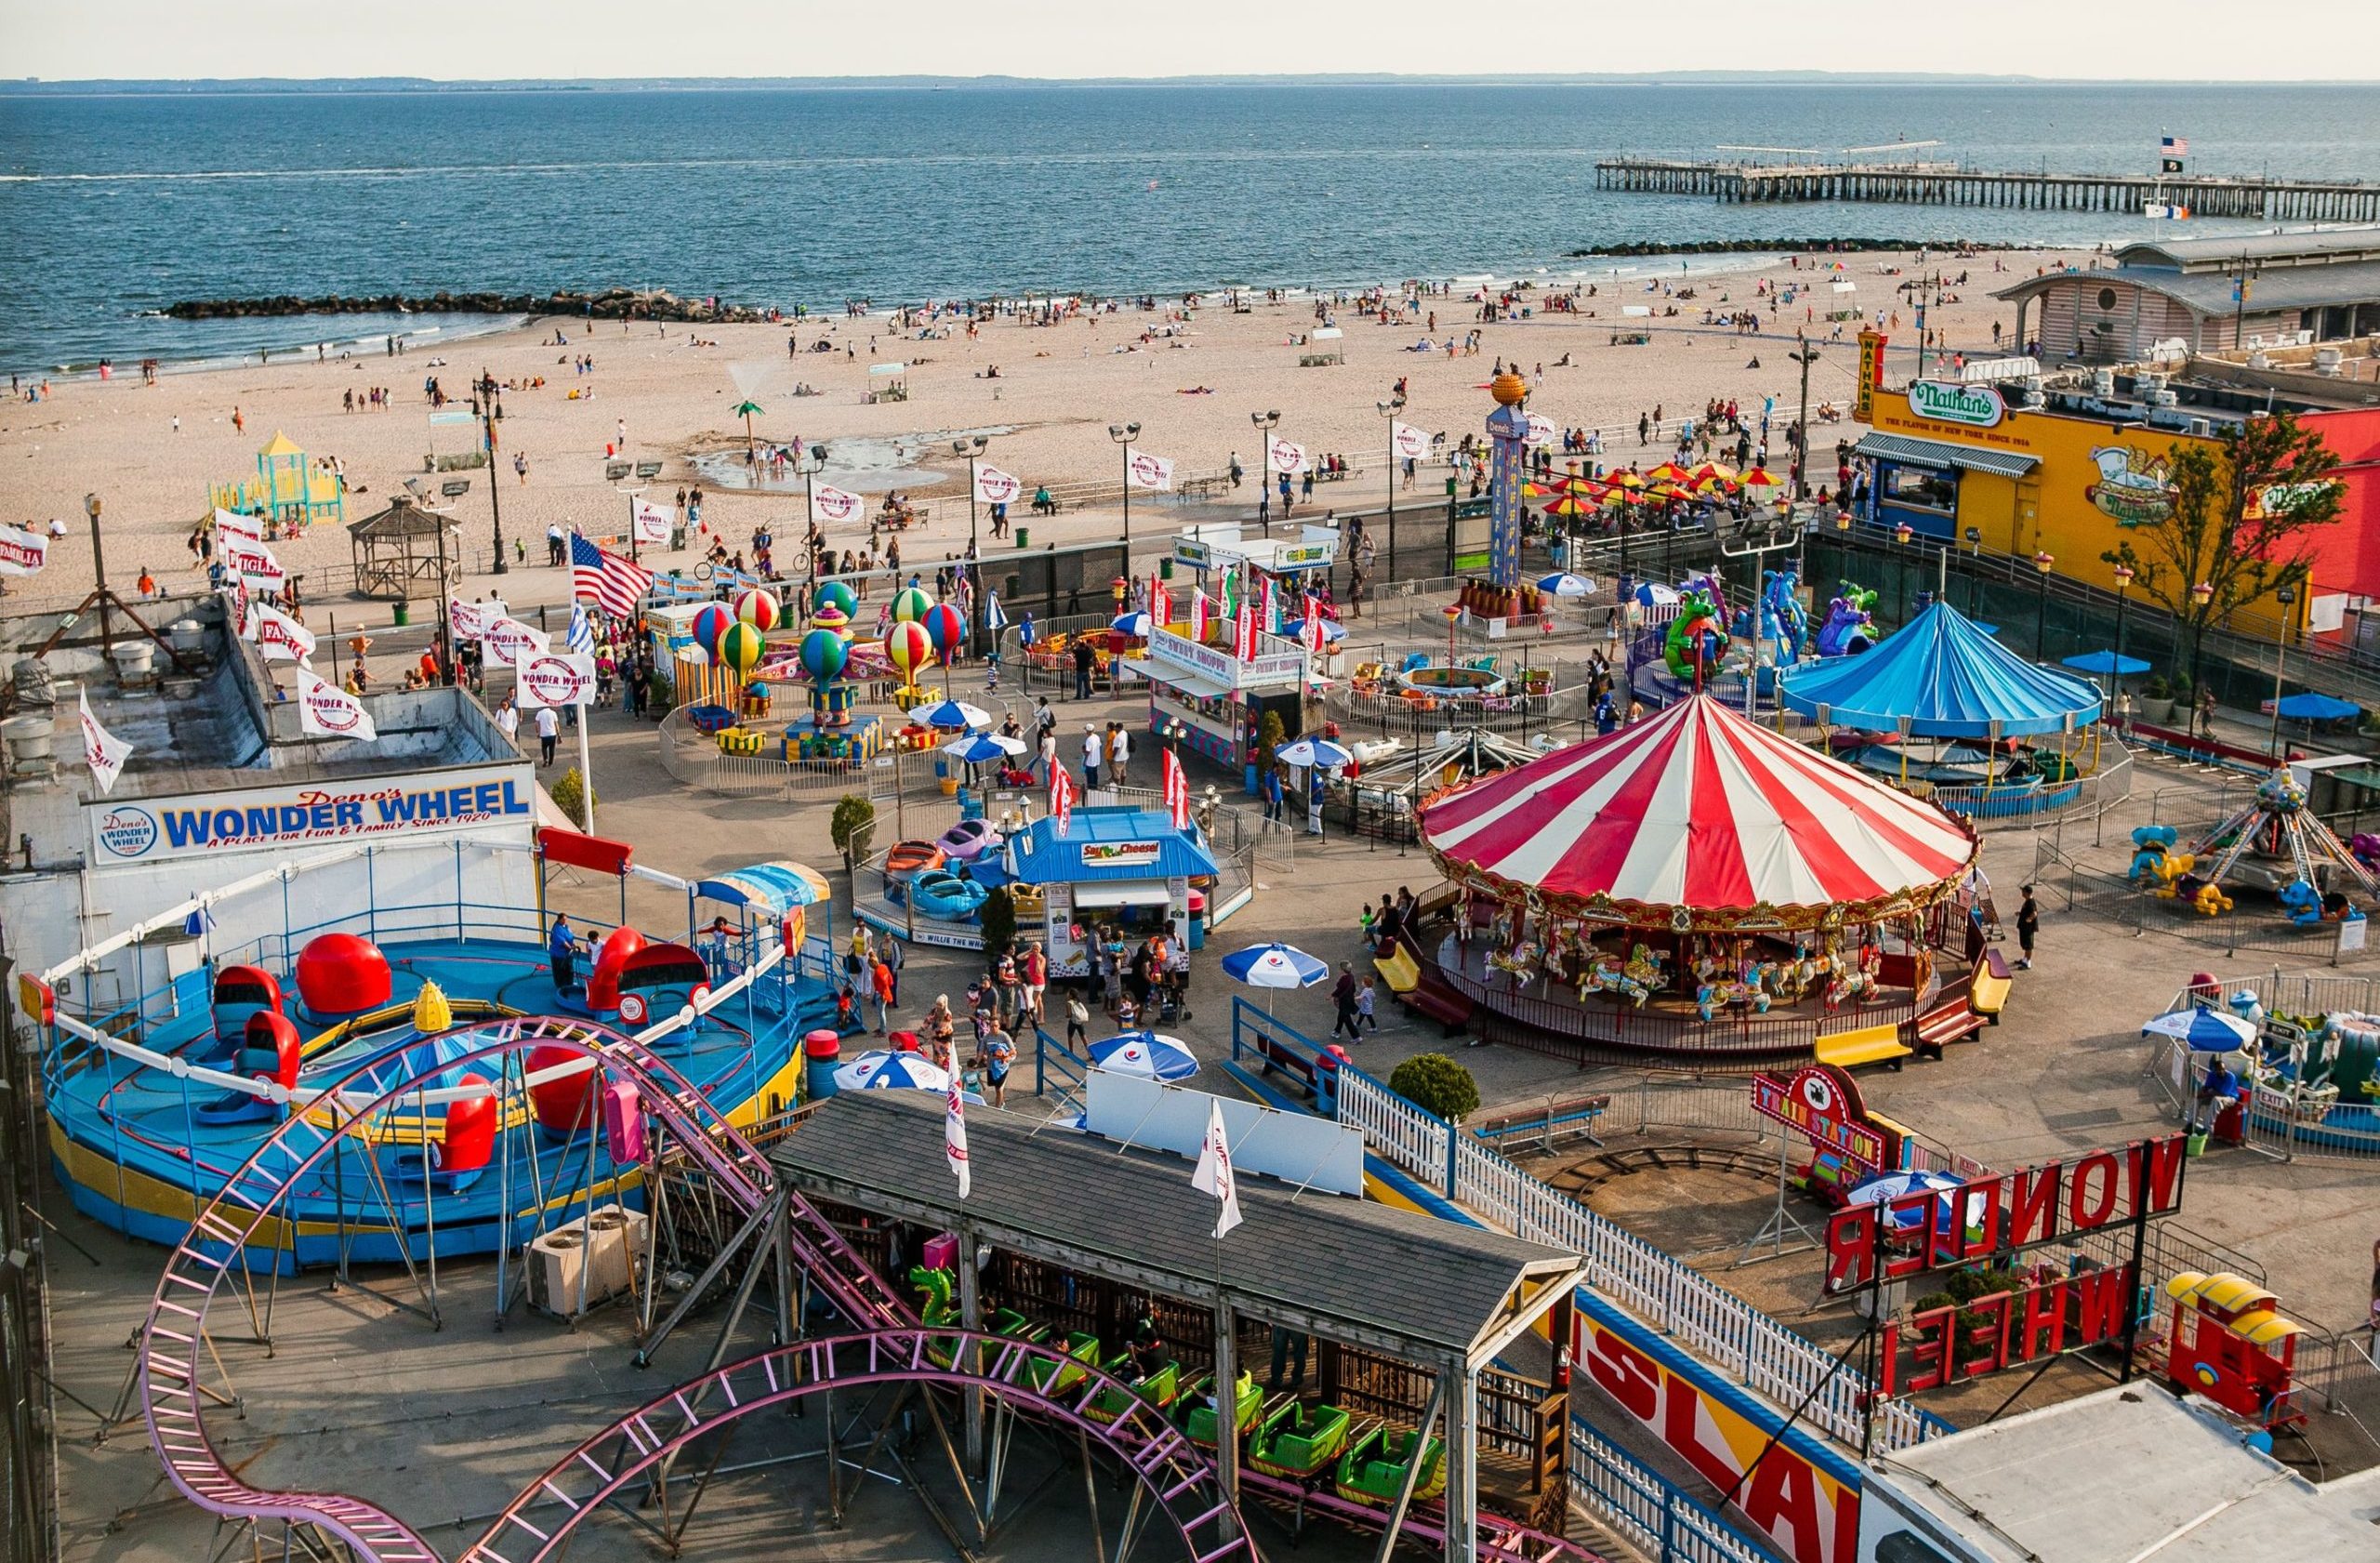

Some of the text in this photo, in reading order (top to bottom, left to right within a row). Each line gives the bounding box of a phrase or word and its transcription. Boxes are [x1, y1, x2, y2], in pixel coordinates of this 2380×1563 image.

[1861, 339, 1874, 411] NATHANS
[1915, 382, 1993, 415] Nathan's
[1489, 421, 1510, 434] Deno's
[1885, 417, 2030, 447] THE FLAVOR OF NEW YORK SINCE 1916
[1168, 638, 1195, 659] SWEET
[1197, 649, 1226, 673] SHOPPE
[522, 673, 592, 686] WONDER WHEEL
[306, 695, 343, 709] WONDER
[297, 788, 403, 807] Deno's
[102, 814, 147, 830] Deno's
[160, 779, 530, 849] WONDER WHEEL
[106, 827, 151, 839] WONDER
[206, 812, 491, 849] A PLACE FOR FUN & FAMILY SINCE 1920
[112, 837, 147, 846] WHEEL
[1083, 841, 1158, 857] Say Cheese!
[927, 934, 950, 944] WILLIE
[953, 937, 966, 947] THE
[2271, 1026, 2291, 1037] EXIT
[2261, 1092, 2283, 1106] EXIT
[1761, 1086, 1873, 1160] TRAIN STATION
[1962, 1159, 1976, 1171] EXIT
